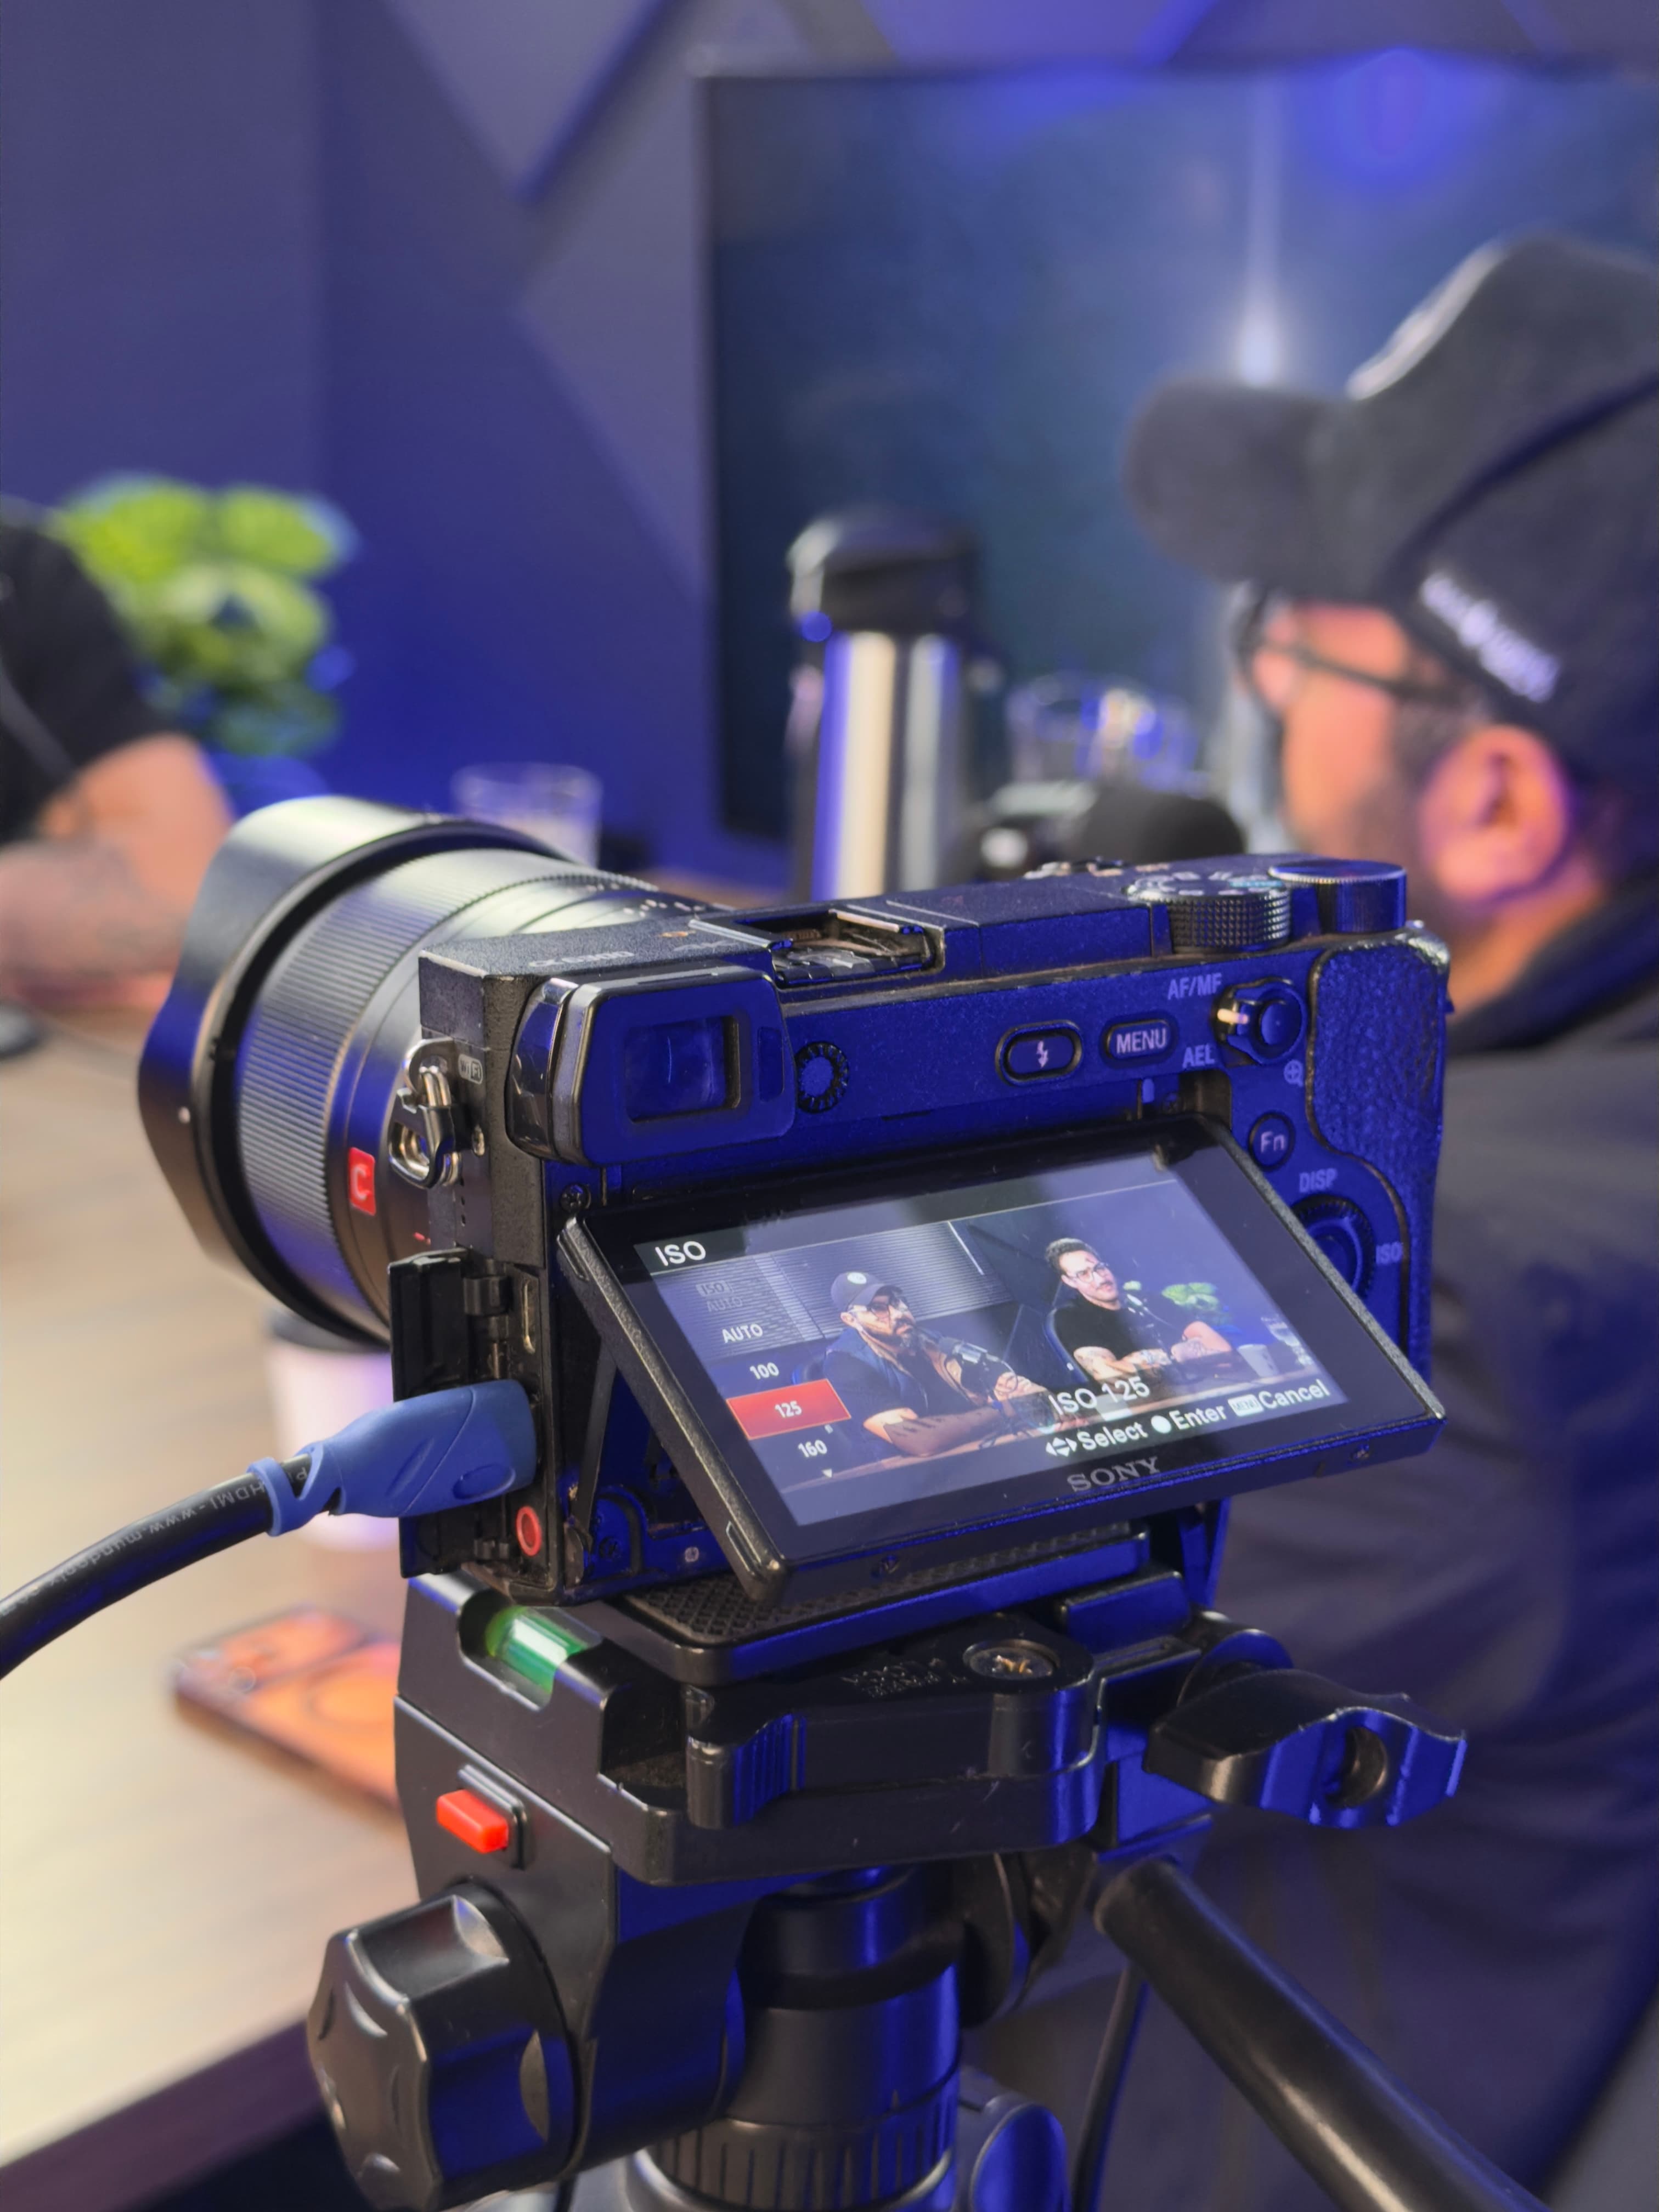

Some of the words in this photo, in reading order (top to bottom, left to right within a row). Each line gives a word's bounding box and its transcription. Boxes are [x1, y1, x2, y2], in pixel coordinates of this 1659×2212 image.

[1167, 972, 1222, 1000] AF/MF
[1116, 1028, 1167, 1054] MENU
[1182, 1044, 1215, 1069] AEL
[1260, 1131, 1285, 1153] Fn
[1299, 1167, 1336, 1193] DISP
[655, 1240, 706, 1266] ISO
[1375, 1241, 1403, 1265] ISO
[721, 1323, 764, 1344] AUTO
[749, 1362, 780, 1380] 100
[1048, 1387, 1097, 1415] ISO
[1101, 1375, 1150, 1403] 125
[775, 1400, 802, 1418] 125
[1076, 1421, 1149, 1450] Select
[1169, 1404, 1227, 1430] Enter
[1258, 1378, 1330, 1409] Cancel
[798, 1439, 828, 1458] 160
[1067, 1455, 1160, 1492] SONY
